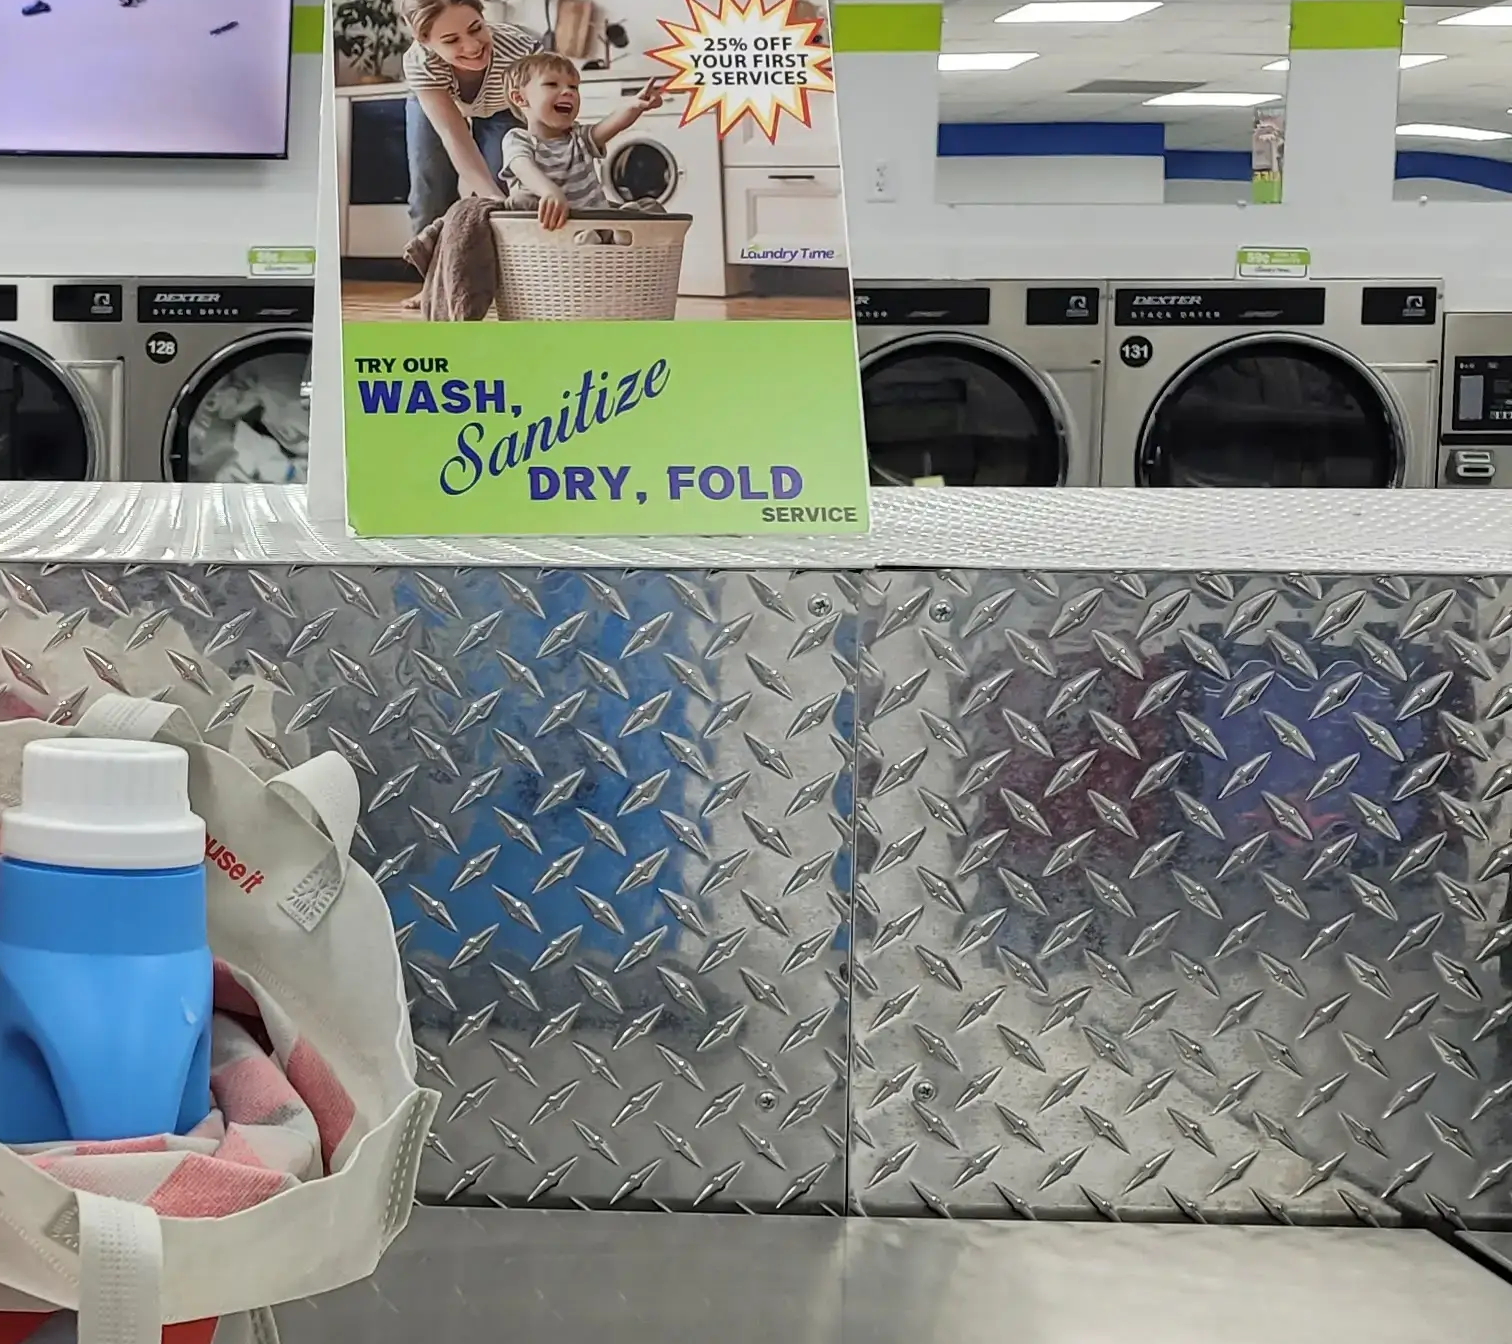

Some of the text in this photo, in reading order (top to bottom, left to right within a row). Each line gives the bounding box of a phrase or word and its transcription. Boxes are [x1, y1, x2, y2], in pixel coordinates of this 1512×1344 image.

[704, 37, 792, 51] 25% OFF
[690, 54, 809, 68] YOUR FIRST
[694, 71, 808, 86] 2 SERVICES
[740, 247, 835, 263] Laundry Time
[153, 293, 220, 303] DEXTER
[1132, 296, 1202, 305] DEXTER
[148, 340, 176, 355] 128
[1121, 345, 1149, 359] 131
[355, 356, 449, 374] TRY OUR
[358, 379, 524, 419] WASH,
[439, 357, 672, 496] Sanitize
[527, 465, 804, 505] DRY, FOLD
[761, 507, 858, 523] SERVICE
[239, 870, 265, 895] it
